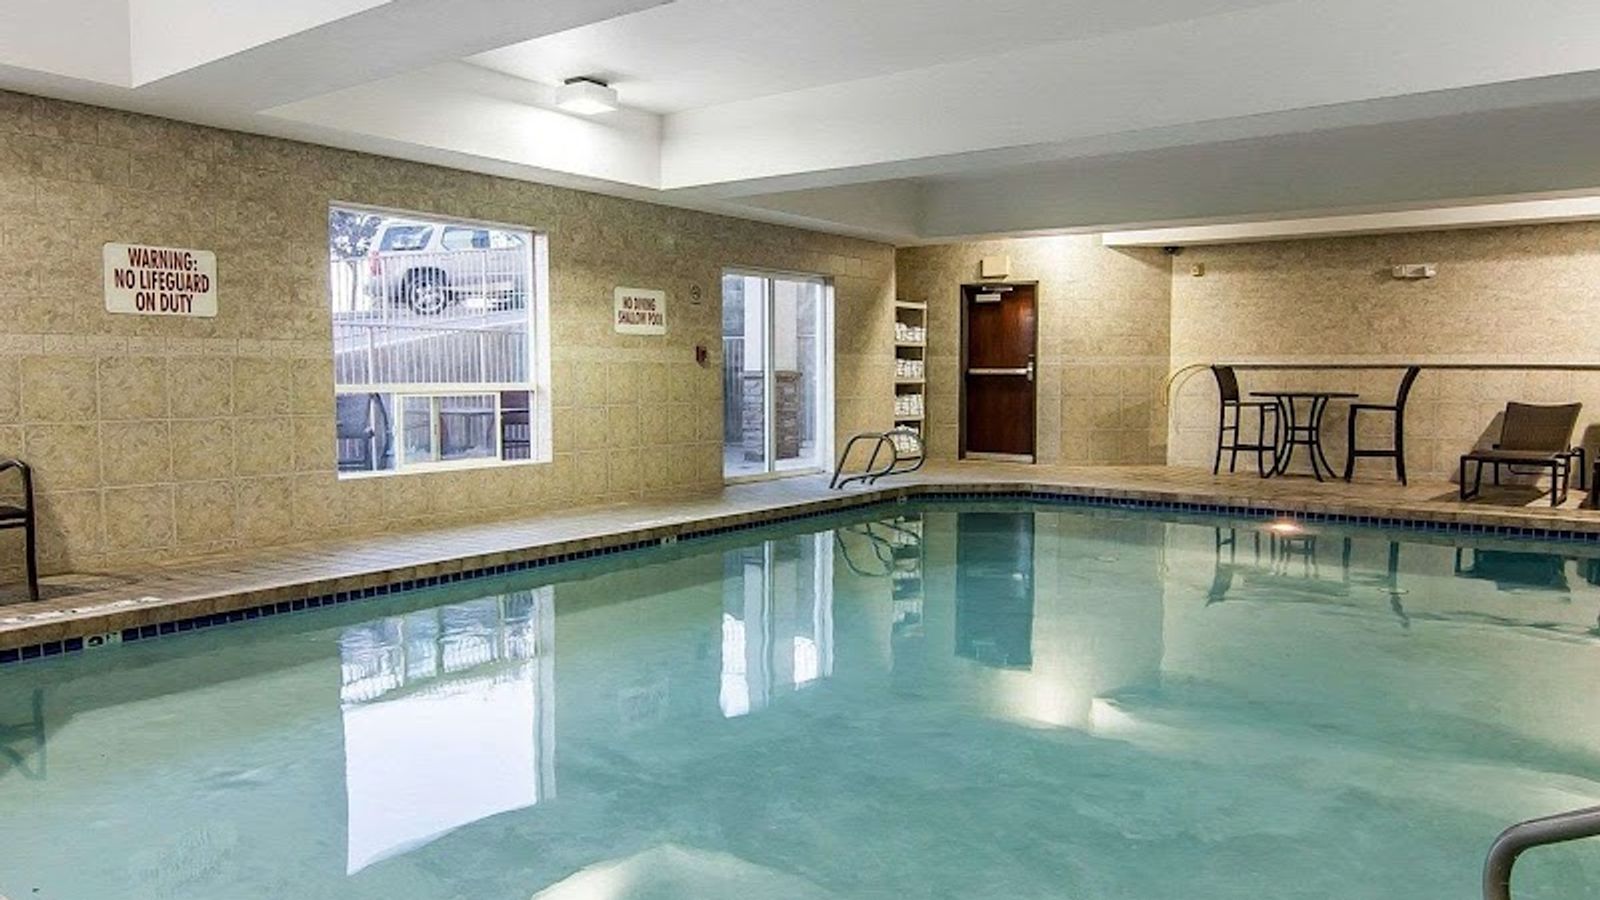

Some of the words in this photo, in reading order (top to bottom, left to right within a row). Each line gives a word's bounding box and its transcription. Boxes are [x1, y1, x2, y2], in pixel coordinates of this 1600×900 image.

[128, 247, 197, 271] WARNING:
[114, 268, 135, 289] NO
[140, 269, 209, 293] LIFEGUARD
[136, 292, 155, 311] ON
[160, 293, 193, 313] DUTY
[622, 296, 633, 310] NO
[634, 297, 656, 311] DIVING
[618, 310, 647, 325] SHALLOW
[648, 312, 663, 326] POOL
